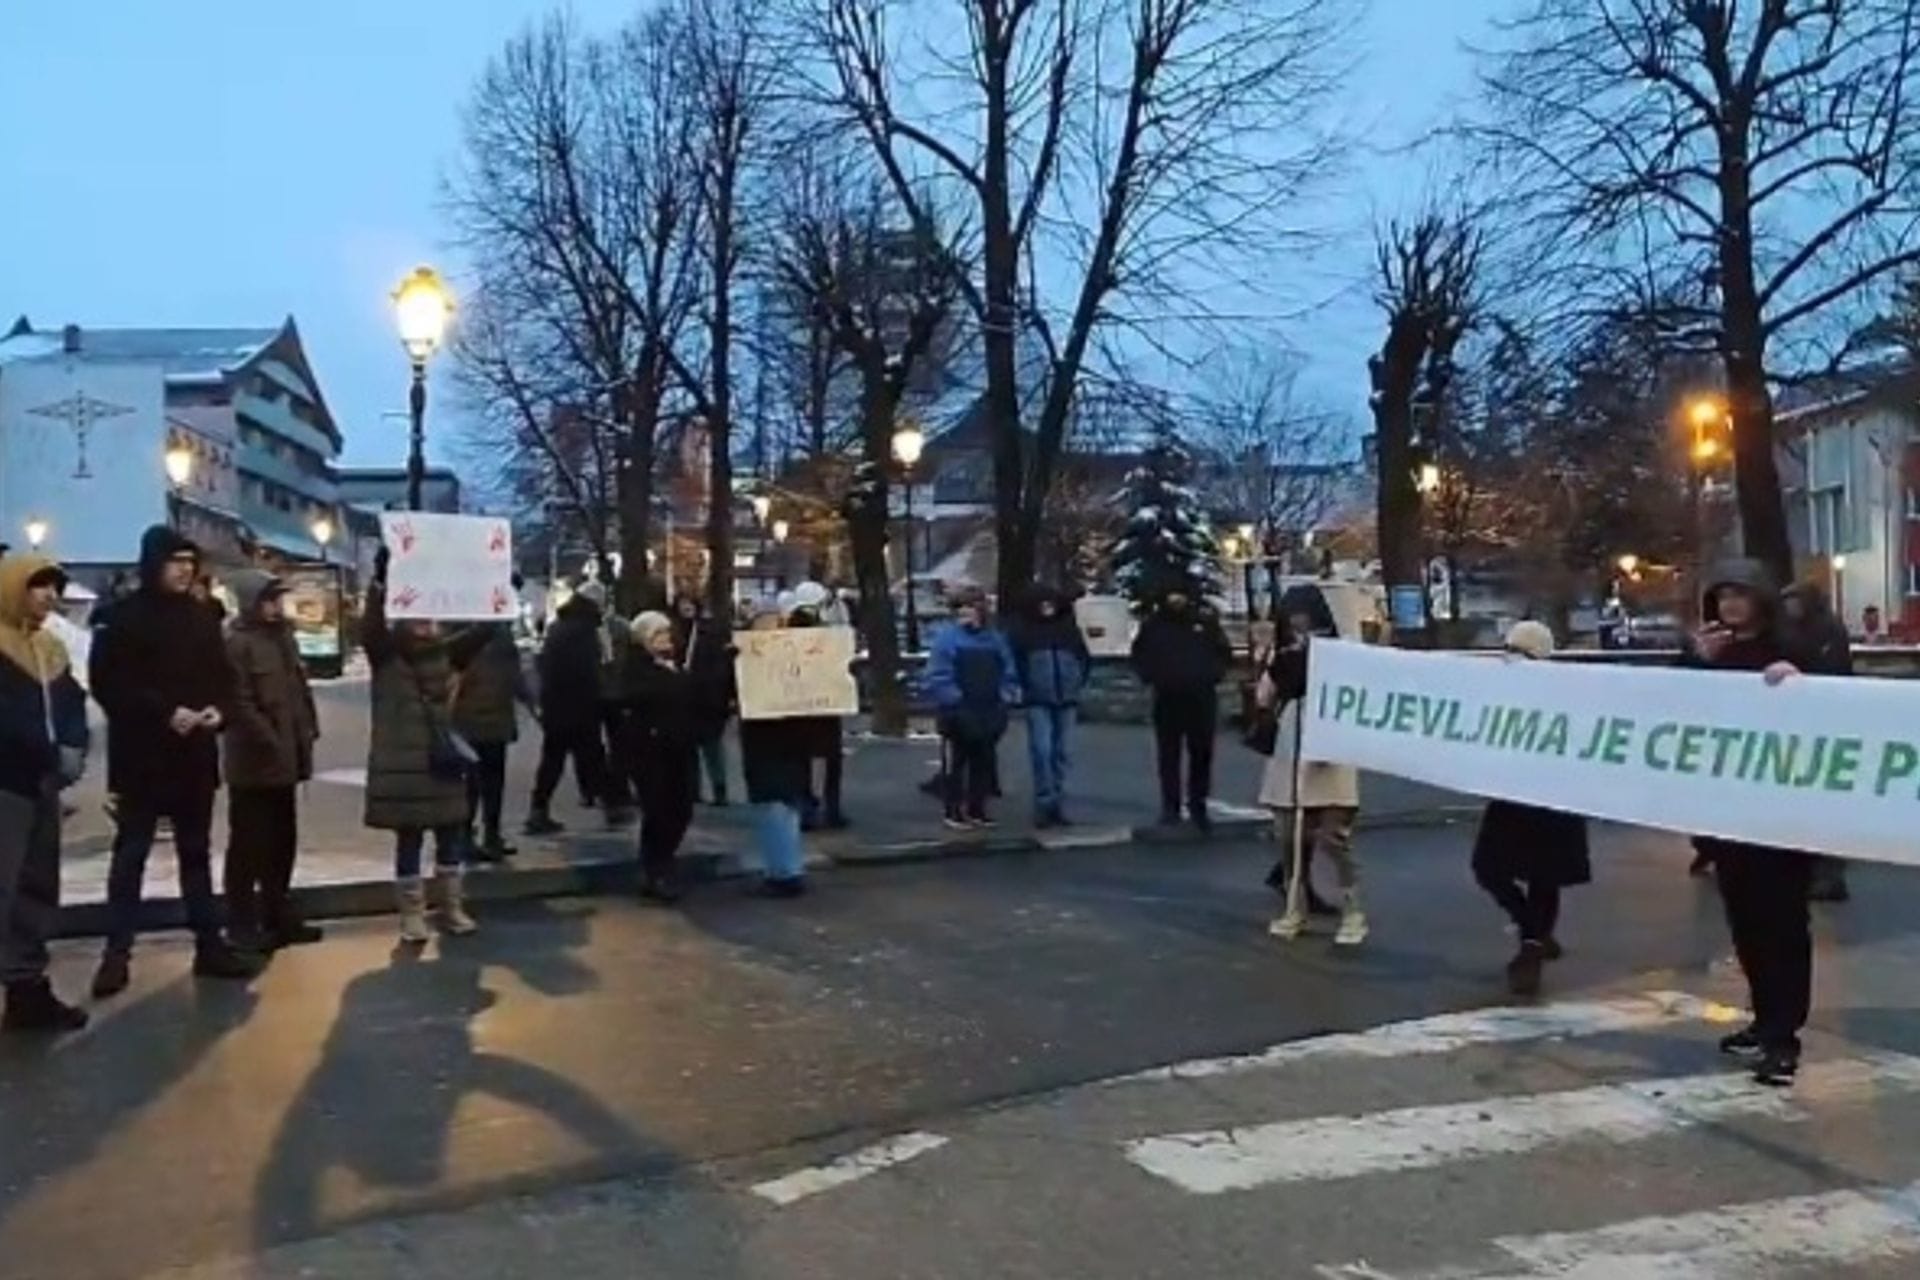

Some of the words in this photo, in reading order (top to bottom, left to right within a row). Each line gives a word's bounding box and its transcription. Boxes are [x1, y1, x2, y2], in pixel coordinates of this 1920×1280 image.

[1319, 682, 1327, 719] I
[1334, 685, 1568, 755] PLJEVLJIMA
[1578, 716, 1635, 764] JE
[1644, 723, 1862, 791] CETINJE
[1875, 741, 1920, 800] P
